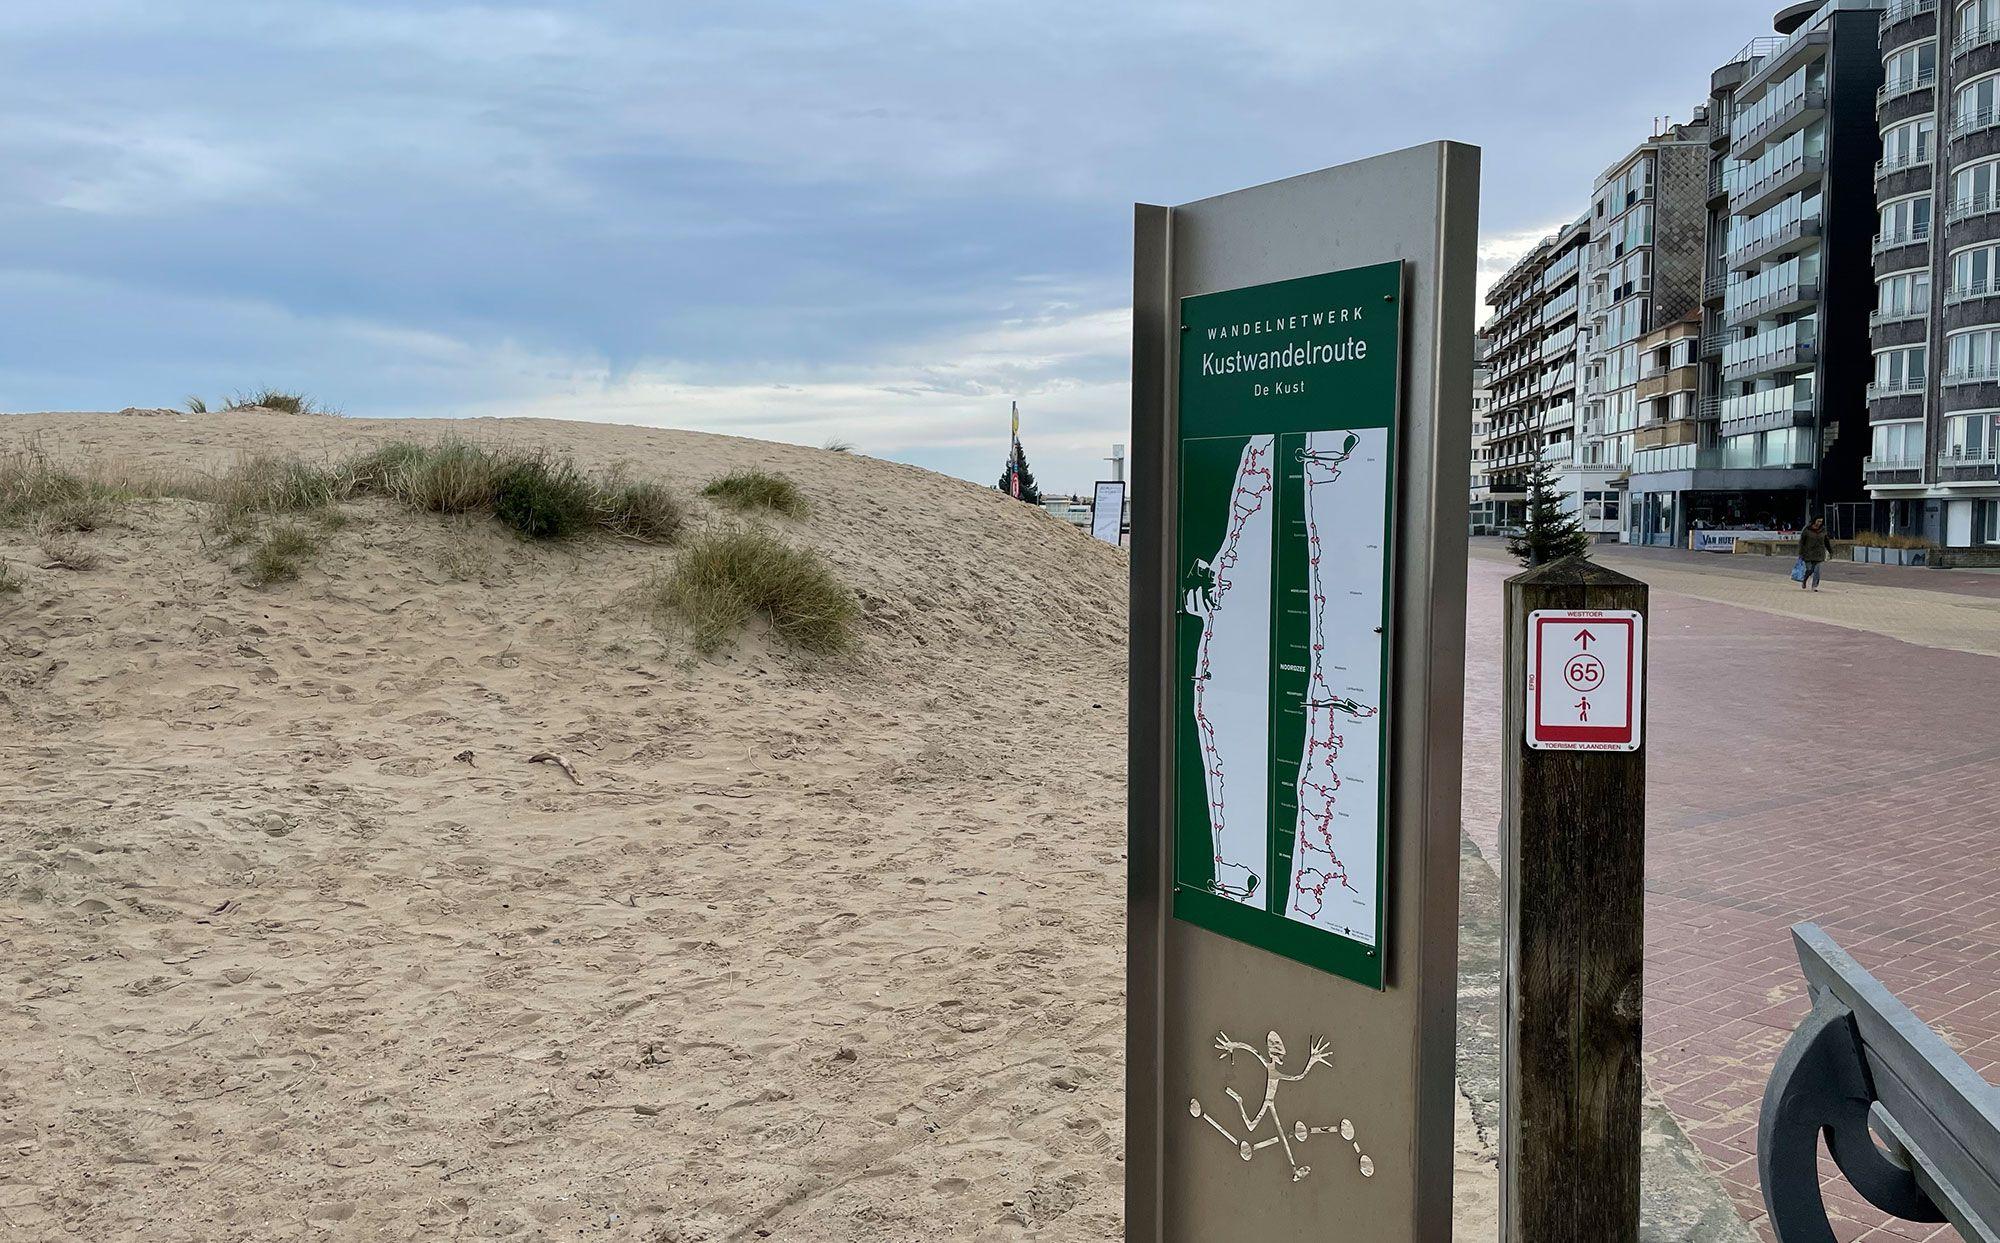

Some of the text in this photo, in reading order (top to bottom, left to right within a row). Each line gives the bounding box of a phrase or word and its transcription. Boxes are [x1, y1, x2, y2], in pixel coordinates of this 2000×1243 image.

[1207, 306, 1363, 340] WANDELNETWERK
[1202, 337, 1367, 376] Kustwandelroute
[1254, 380, 1305, 397] De Kust
[1280, 663, 1306, 673] NOORDZEE
[1570, 663, 1598, 682] 65
[1545, 742, 1622, 751] TOERISME VLAANDEREN
